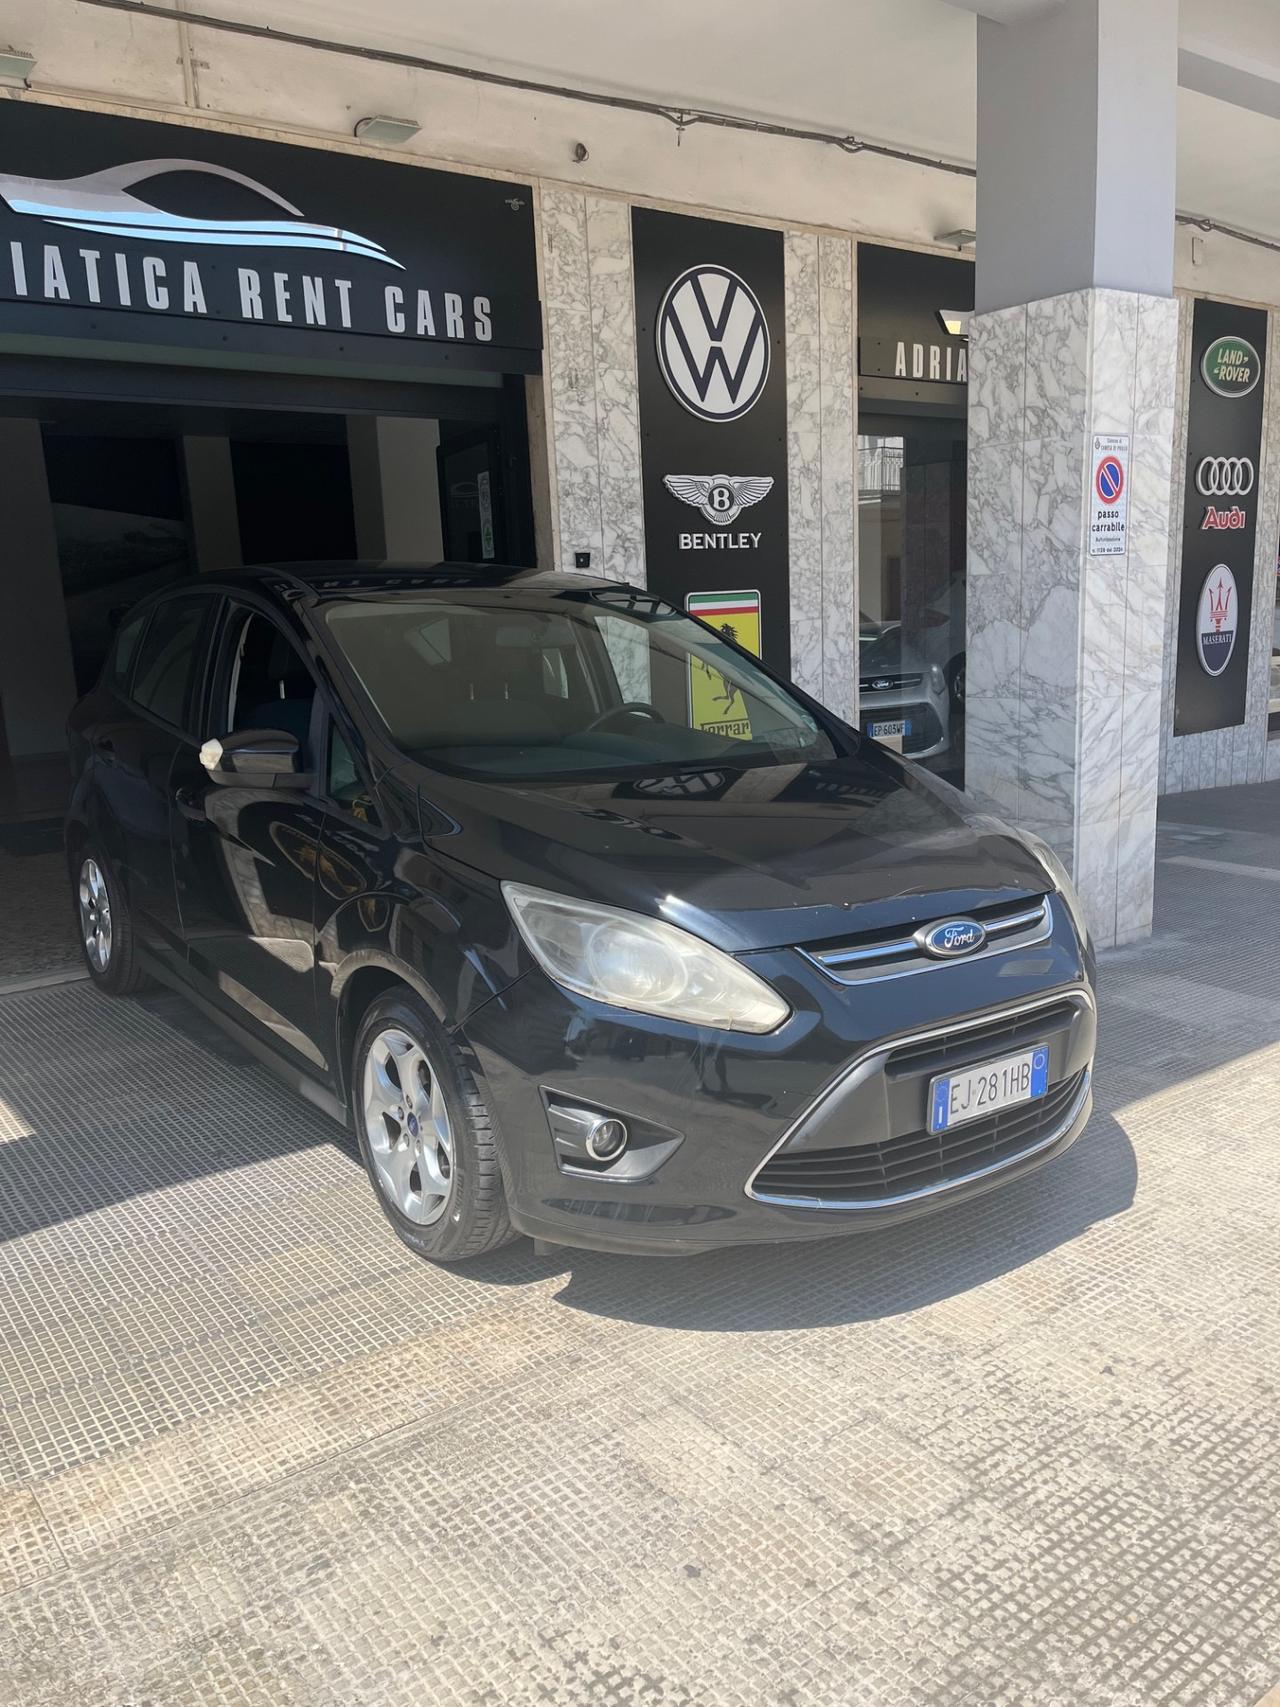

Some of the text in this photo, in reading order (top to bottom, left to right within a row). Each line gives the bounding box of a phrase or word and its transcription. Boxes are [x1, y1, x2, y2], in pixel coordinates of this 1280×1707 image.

[238, 268, 352, 328] RENT
[384, 286, 492, 342] CARS
[895, 341, 967, 382] ADRIA
[1097, 510, 1119, 520] passo
[1202, 506, 1246, 530] Audi
[1091, 522, 1125, 532] carrabile
[679, 532, 762, 550] BENTLEY
[1202, 633, 1233, 645] MASERATI
[944, 926, 976, 948] Ford
